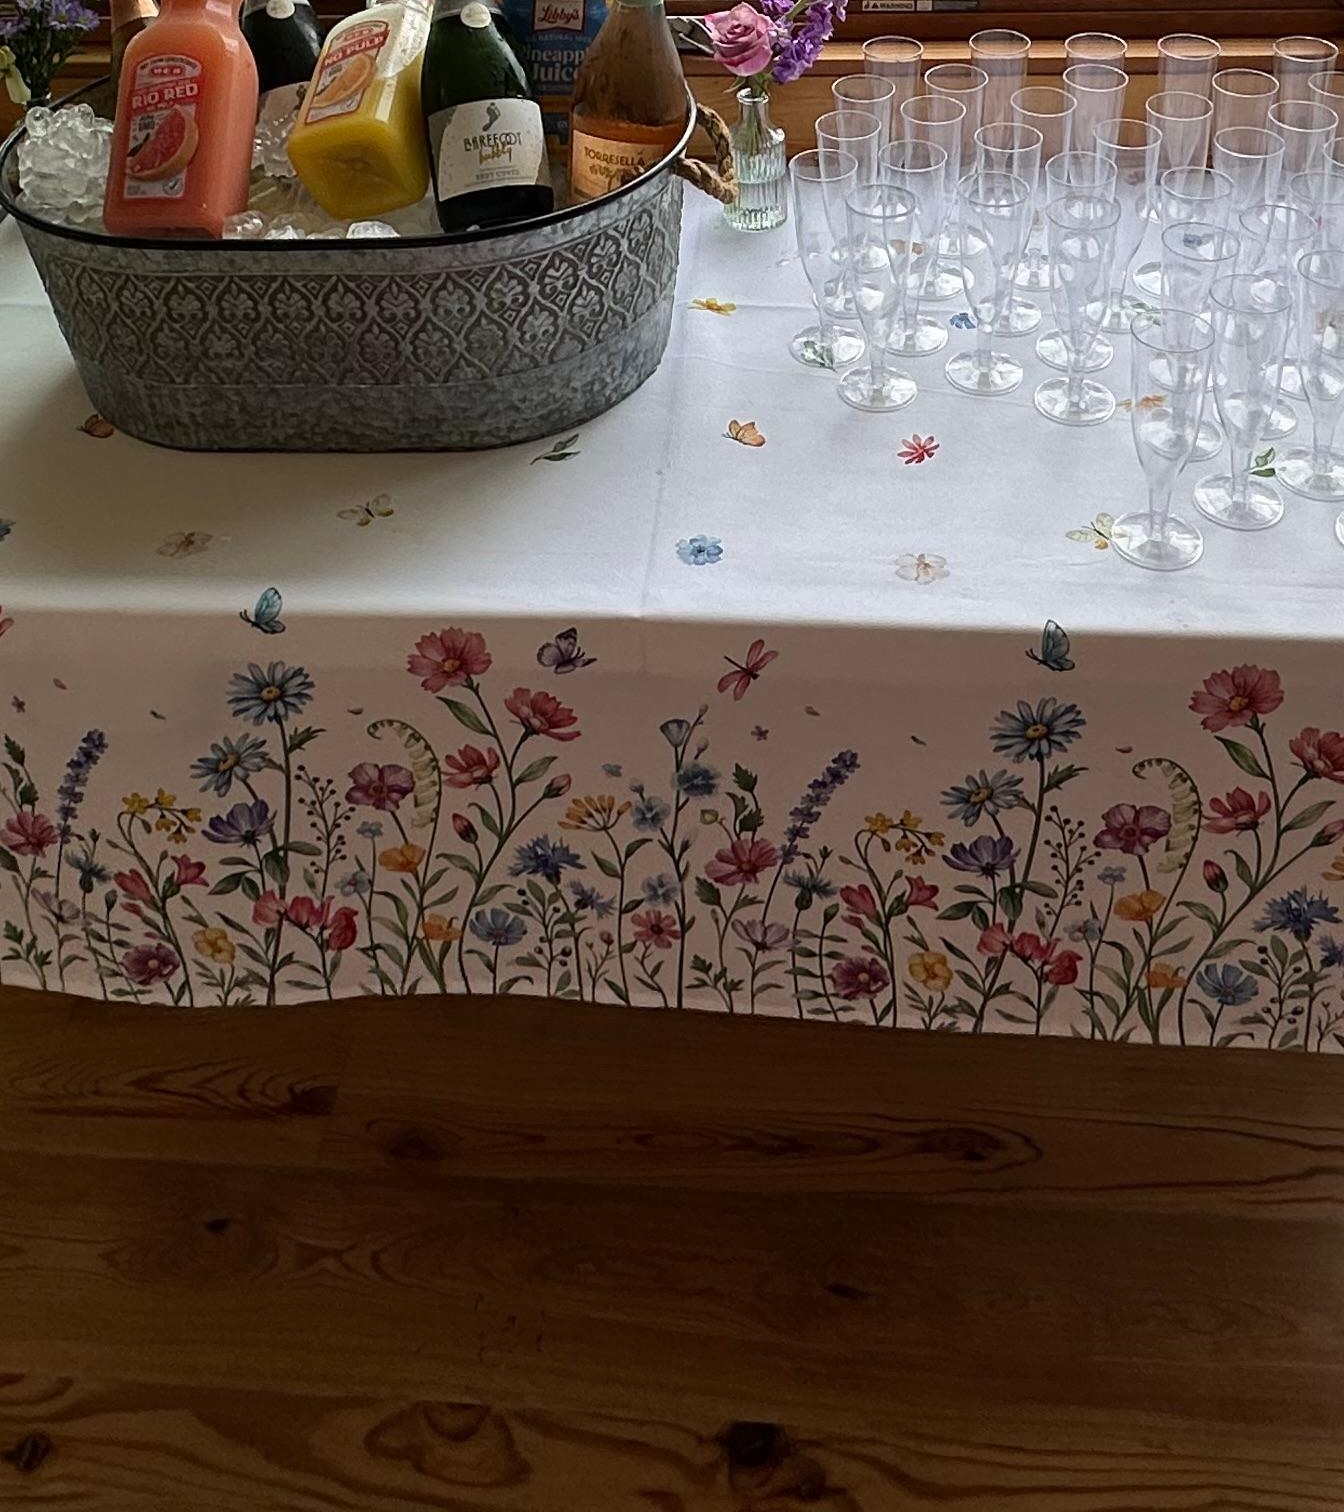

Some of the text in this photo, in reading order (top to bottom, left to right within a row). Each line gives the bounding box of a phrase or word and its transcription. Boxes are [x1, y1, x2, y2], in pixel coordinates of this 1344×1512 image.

[539, 3, 580, 24] Libby's
[324, 36, 384, 66] NO PULP
[132, 91, 160, 108] RIO
[164, 83, 199, 100] RED
[463, 132, 522, 152] BAREFOOT
